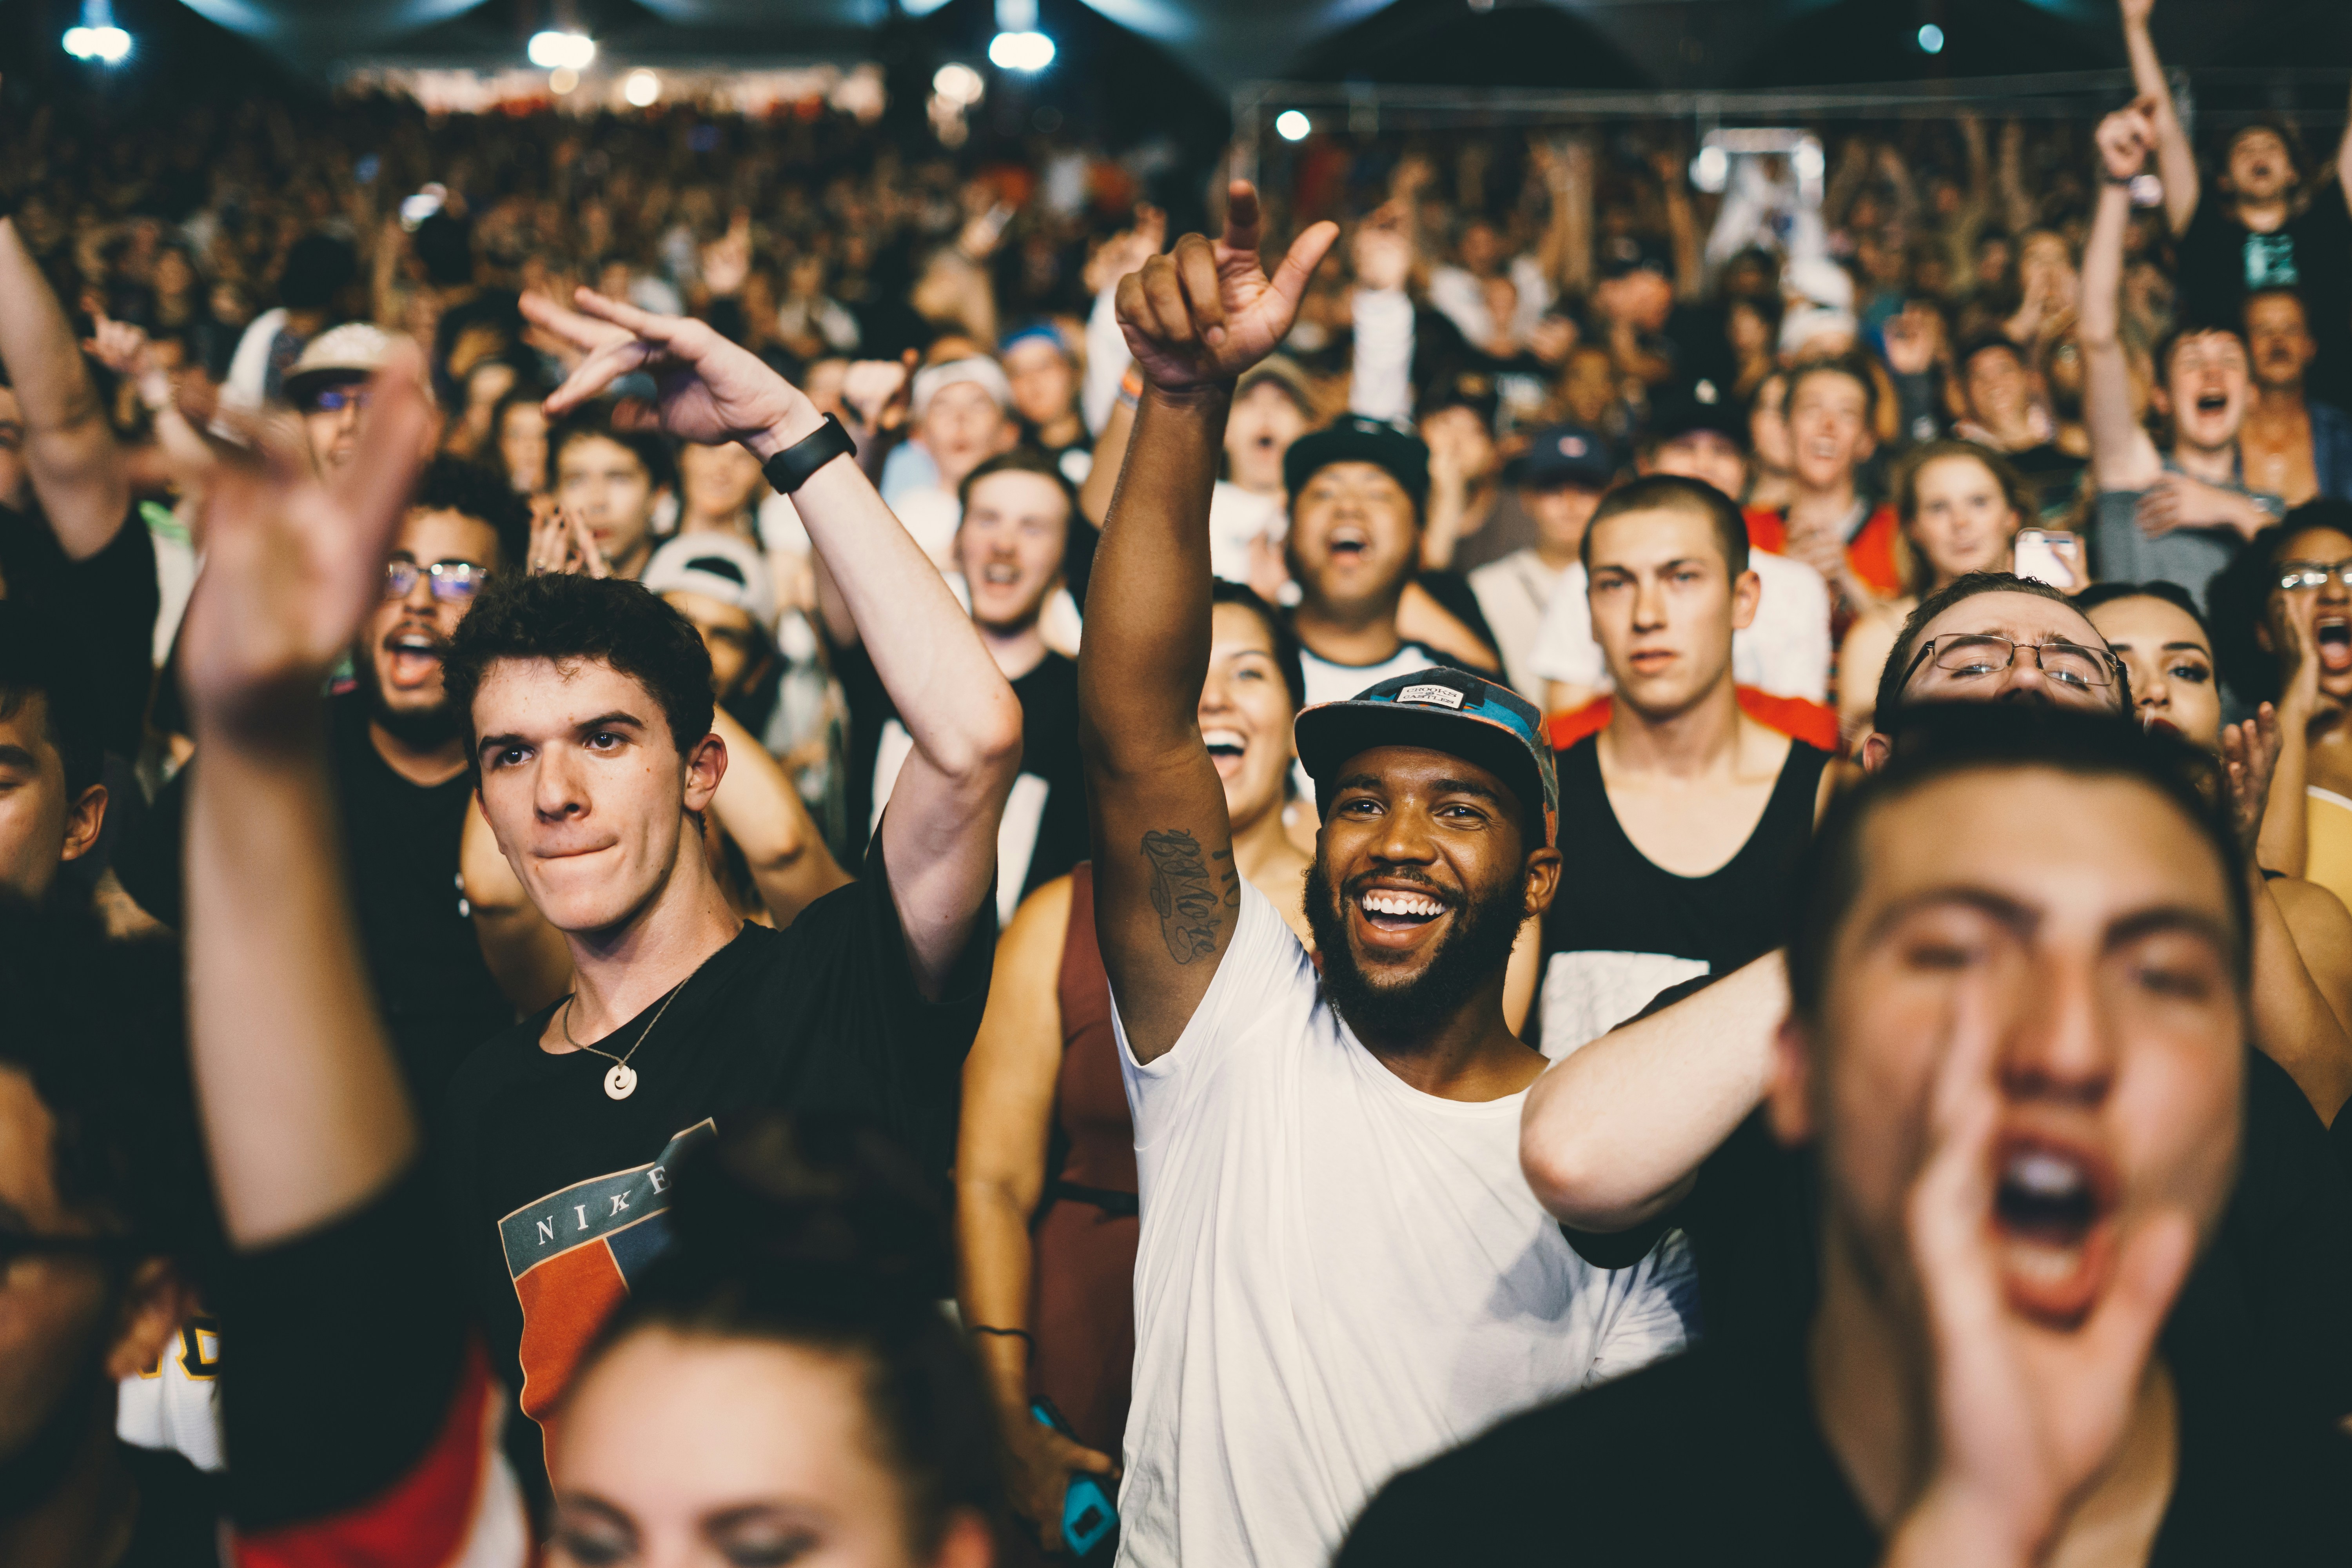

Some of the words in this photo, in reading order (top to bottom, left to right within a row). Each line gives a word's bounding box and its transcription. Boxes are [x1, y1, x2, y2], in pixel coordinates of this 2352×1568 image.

[1406, 687, 1457, 697] CROOKS
[1403, 695, 1454, 704] CASTLES
[536, 1165, 672, 1246] NIKE
